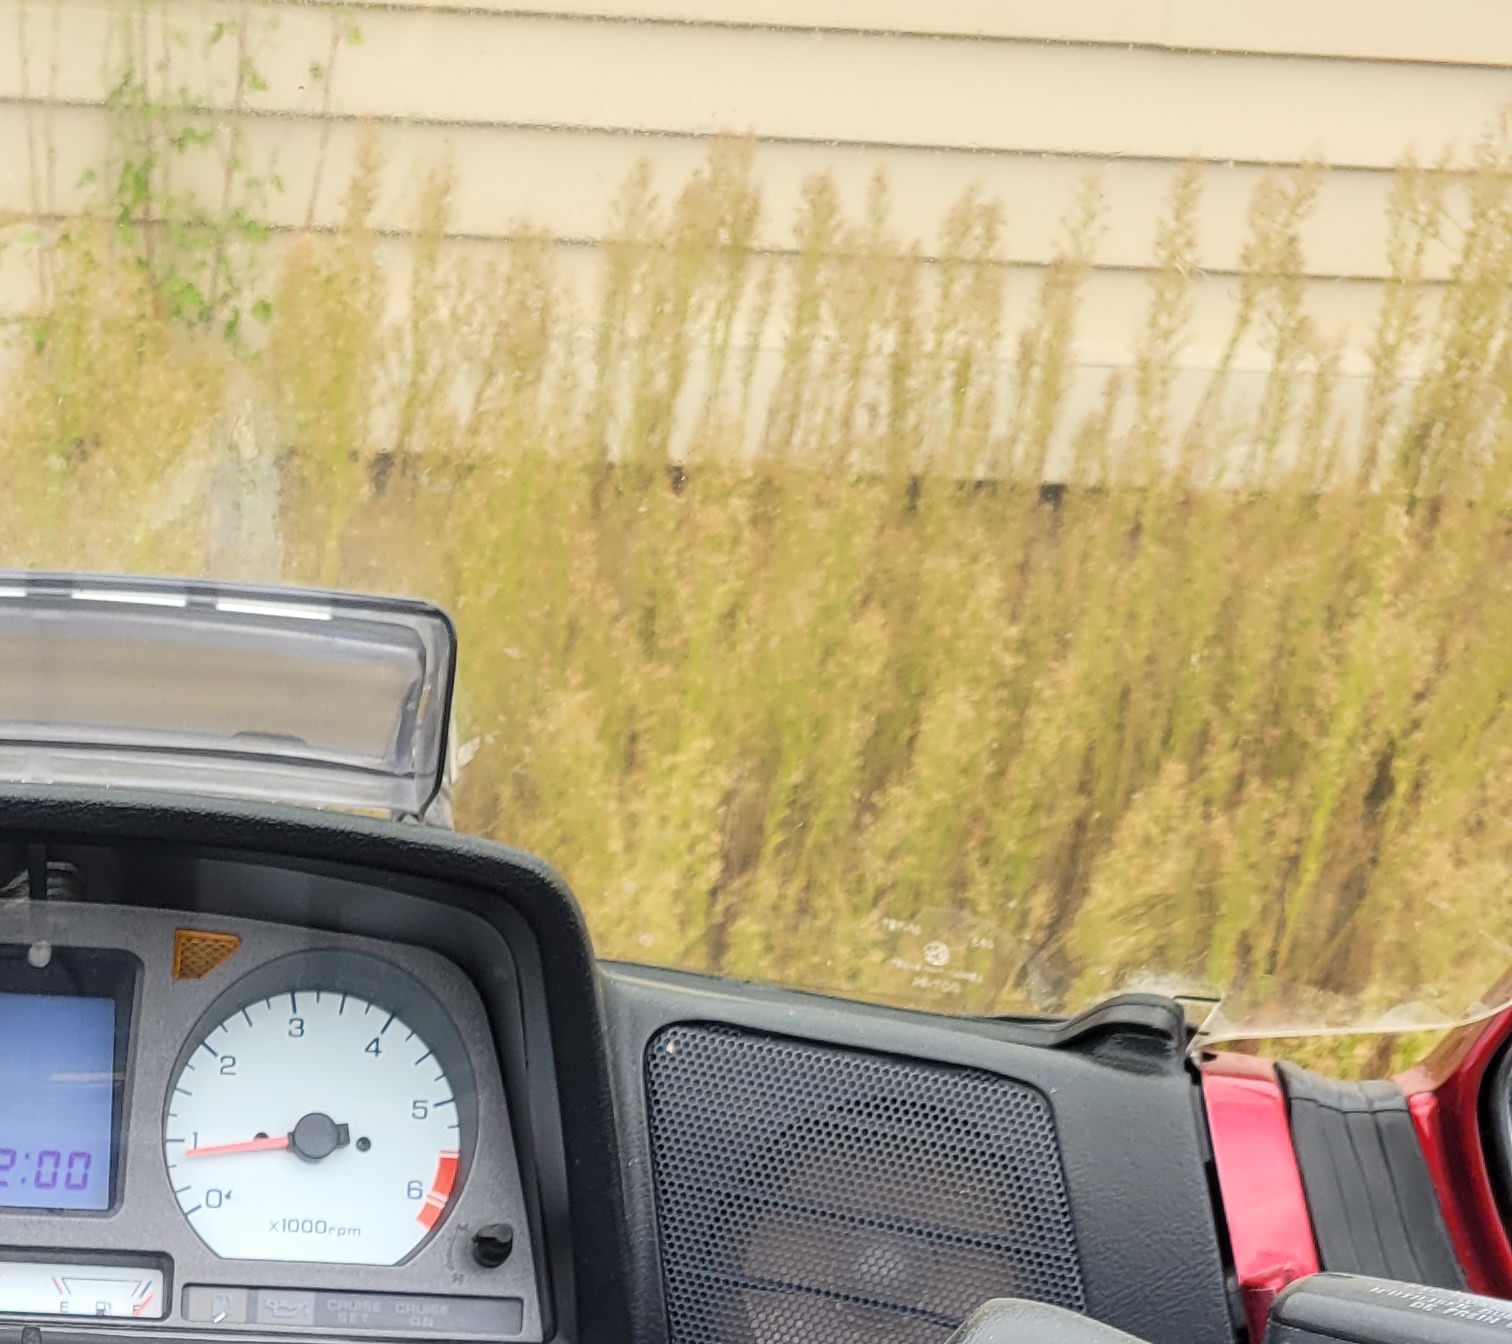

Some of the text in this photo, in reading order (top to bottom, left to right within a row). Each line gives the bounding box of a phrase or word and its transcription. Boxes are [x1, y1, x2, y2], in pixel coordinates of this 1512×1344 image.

[287, 1018, 305, 1038] 3
[364, 1037, 382, 1057] 4
[219, 1055, 237, 1075] 2
[411, 1100, 428, 1120] 5
[406, 1180, 423, 1200] 6
[59, 1301, 70, 1314] E
